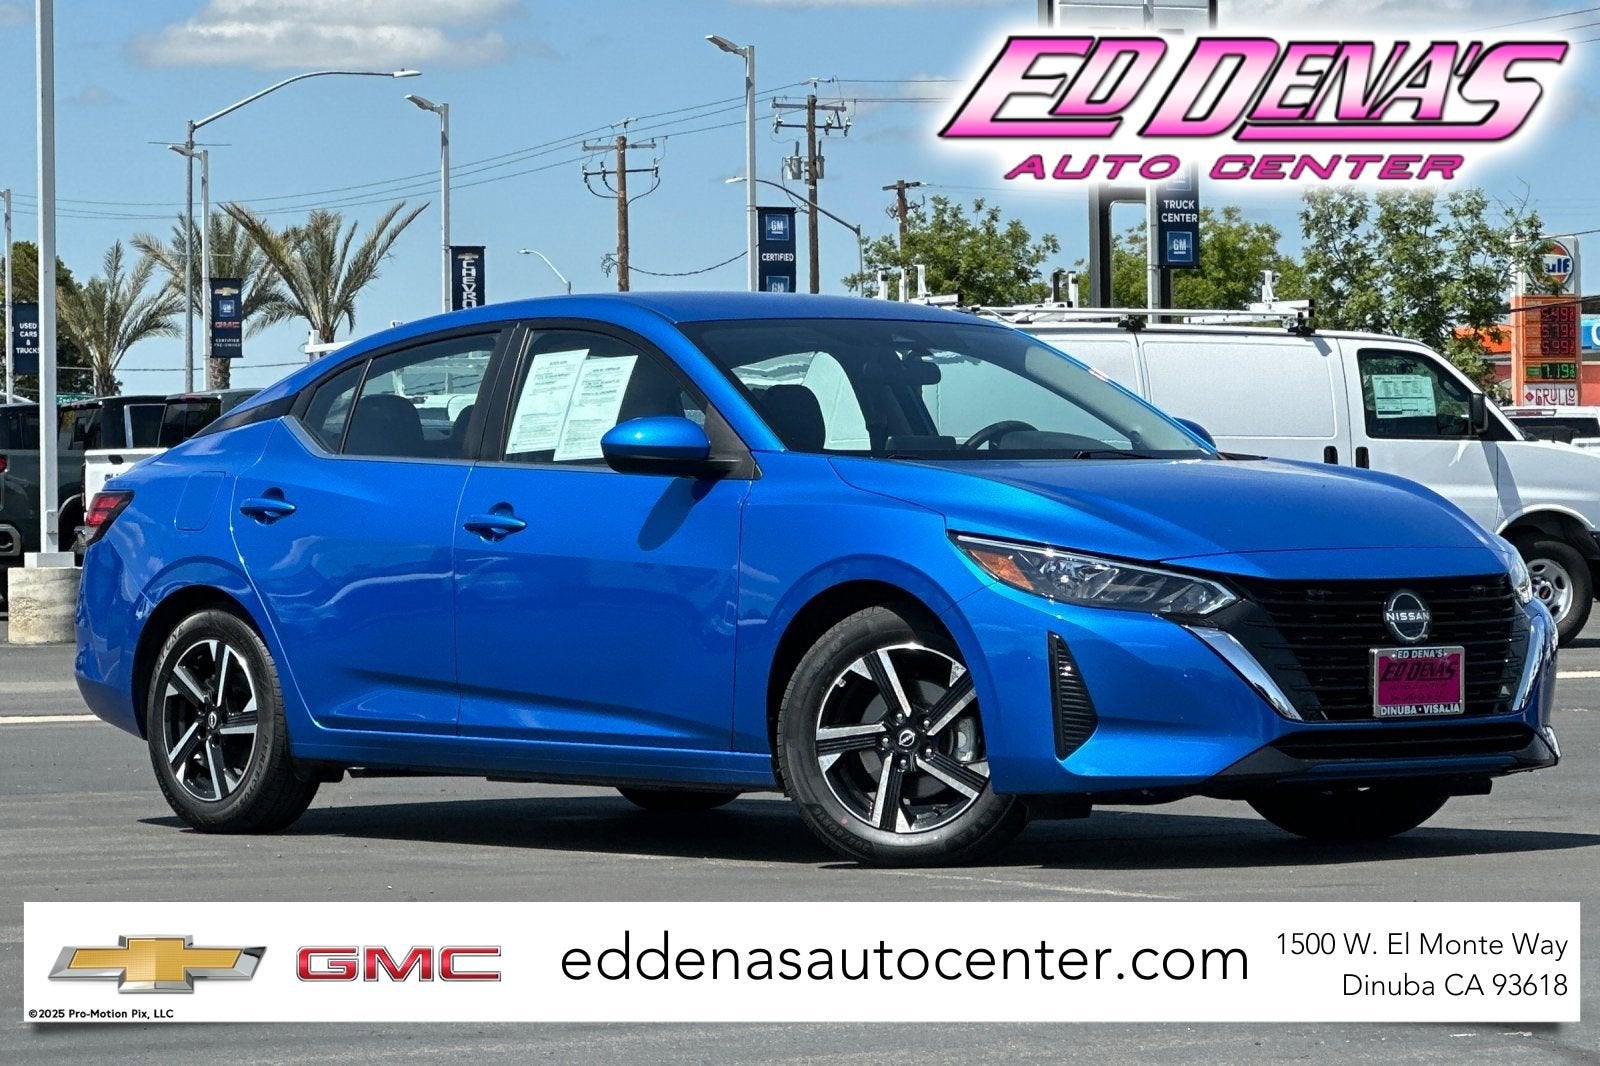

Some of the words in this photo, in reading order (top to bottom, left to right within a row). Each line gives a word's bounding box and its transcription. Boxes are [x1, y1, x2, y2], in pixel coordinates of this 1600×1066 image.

[1163, 199, 1195, 209] TRUCK
[1161, 213, 1198, 223] CENTER
[771, 220, 784, 231] GM
[1173, 239, 1187, 251] GM
[761, 252, 794, 262] CERTIFIED
[1545, 257, 1571, 273] ulf
[1385, 612, 1430, 621] NISSAN
[1397, 650, 1409, 659] ED
[1411, 649, 1443, 659] DENA'S
[1380, 705, 1417, 716] DINUBA
